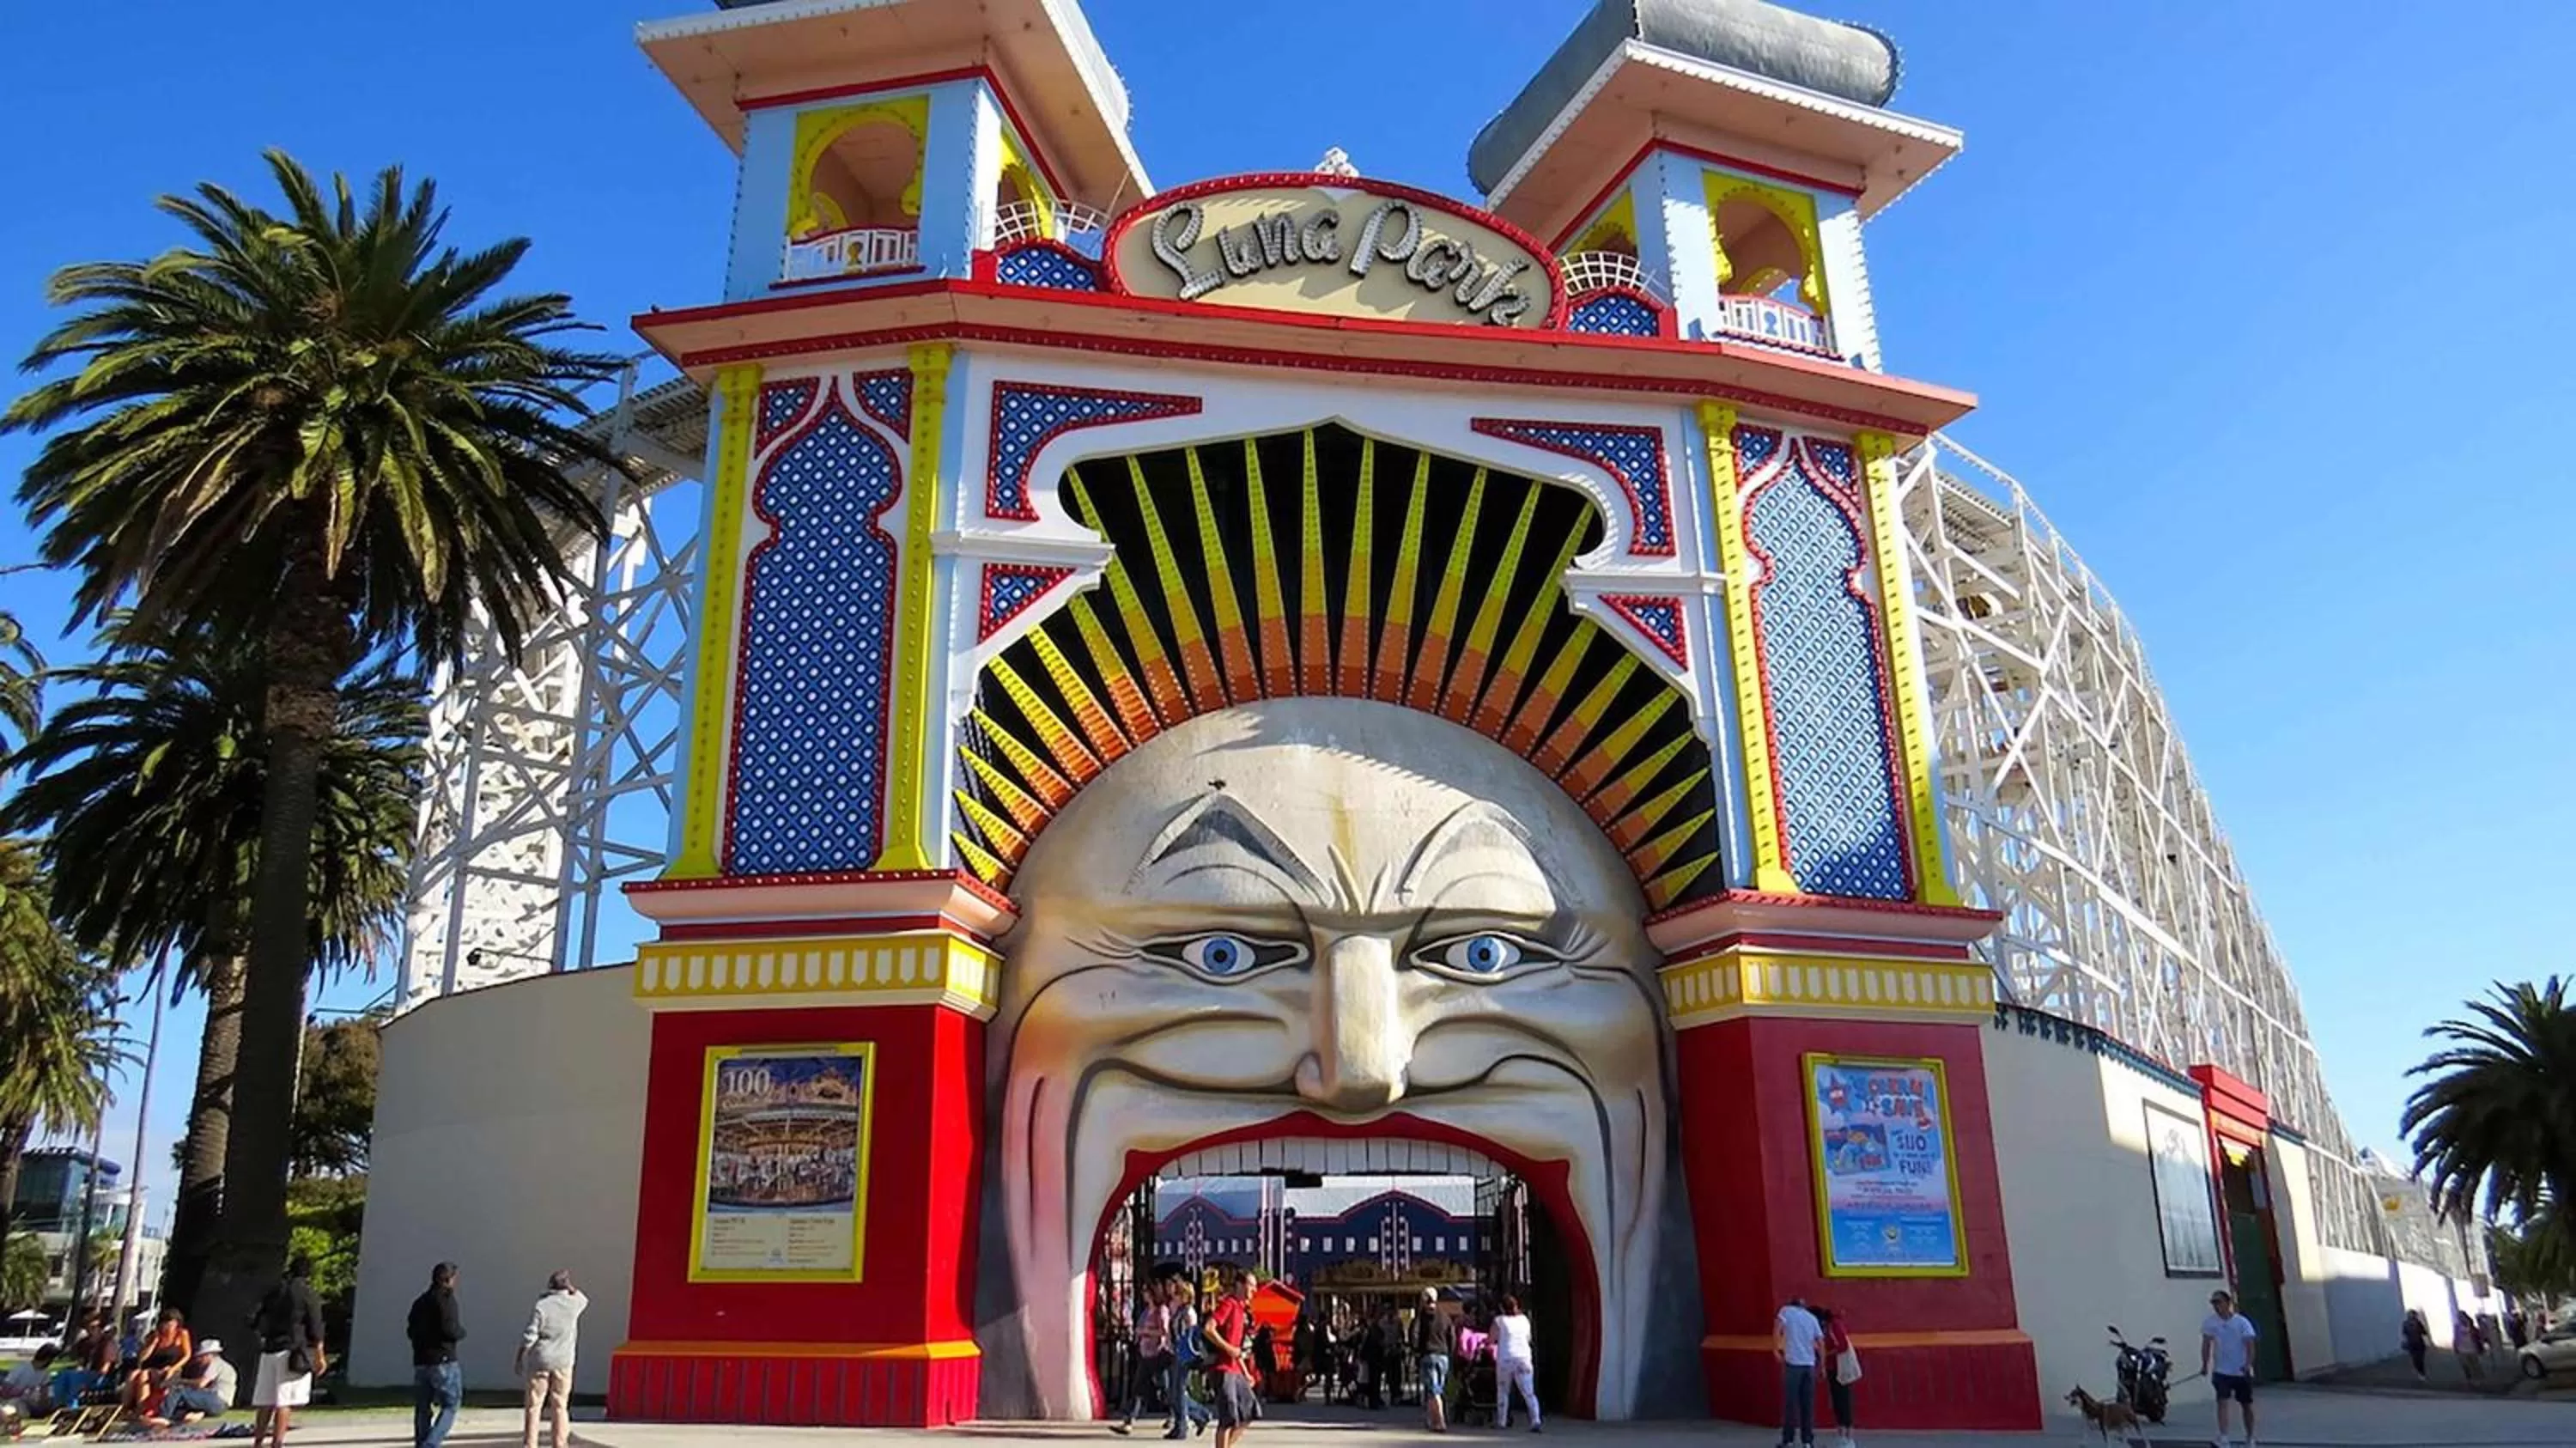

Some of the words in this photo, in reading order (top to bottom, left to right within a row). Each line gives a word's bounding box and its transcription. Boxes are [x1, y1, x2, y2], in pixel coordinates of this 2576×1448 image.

[1151, 201, 1341, 301] Luna
[1349, 198, 1530, 327] Park
[723, 1067, 771, 1097] 100
